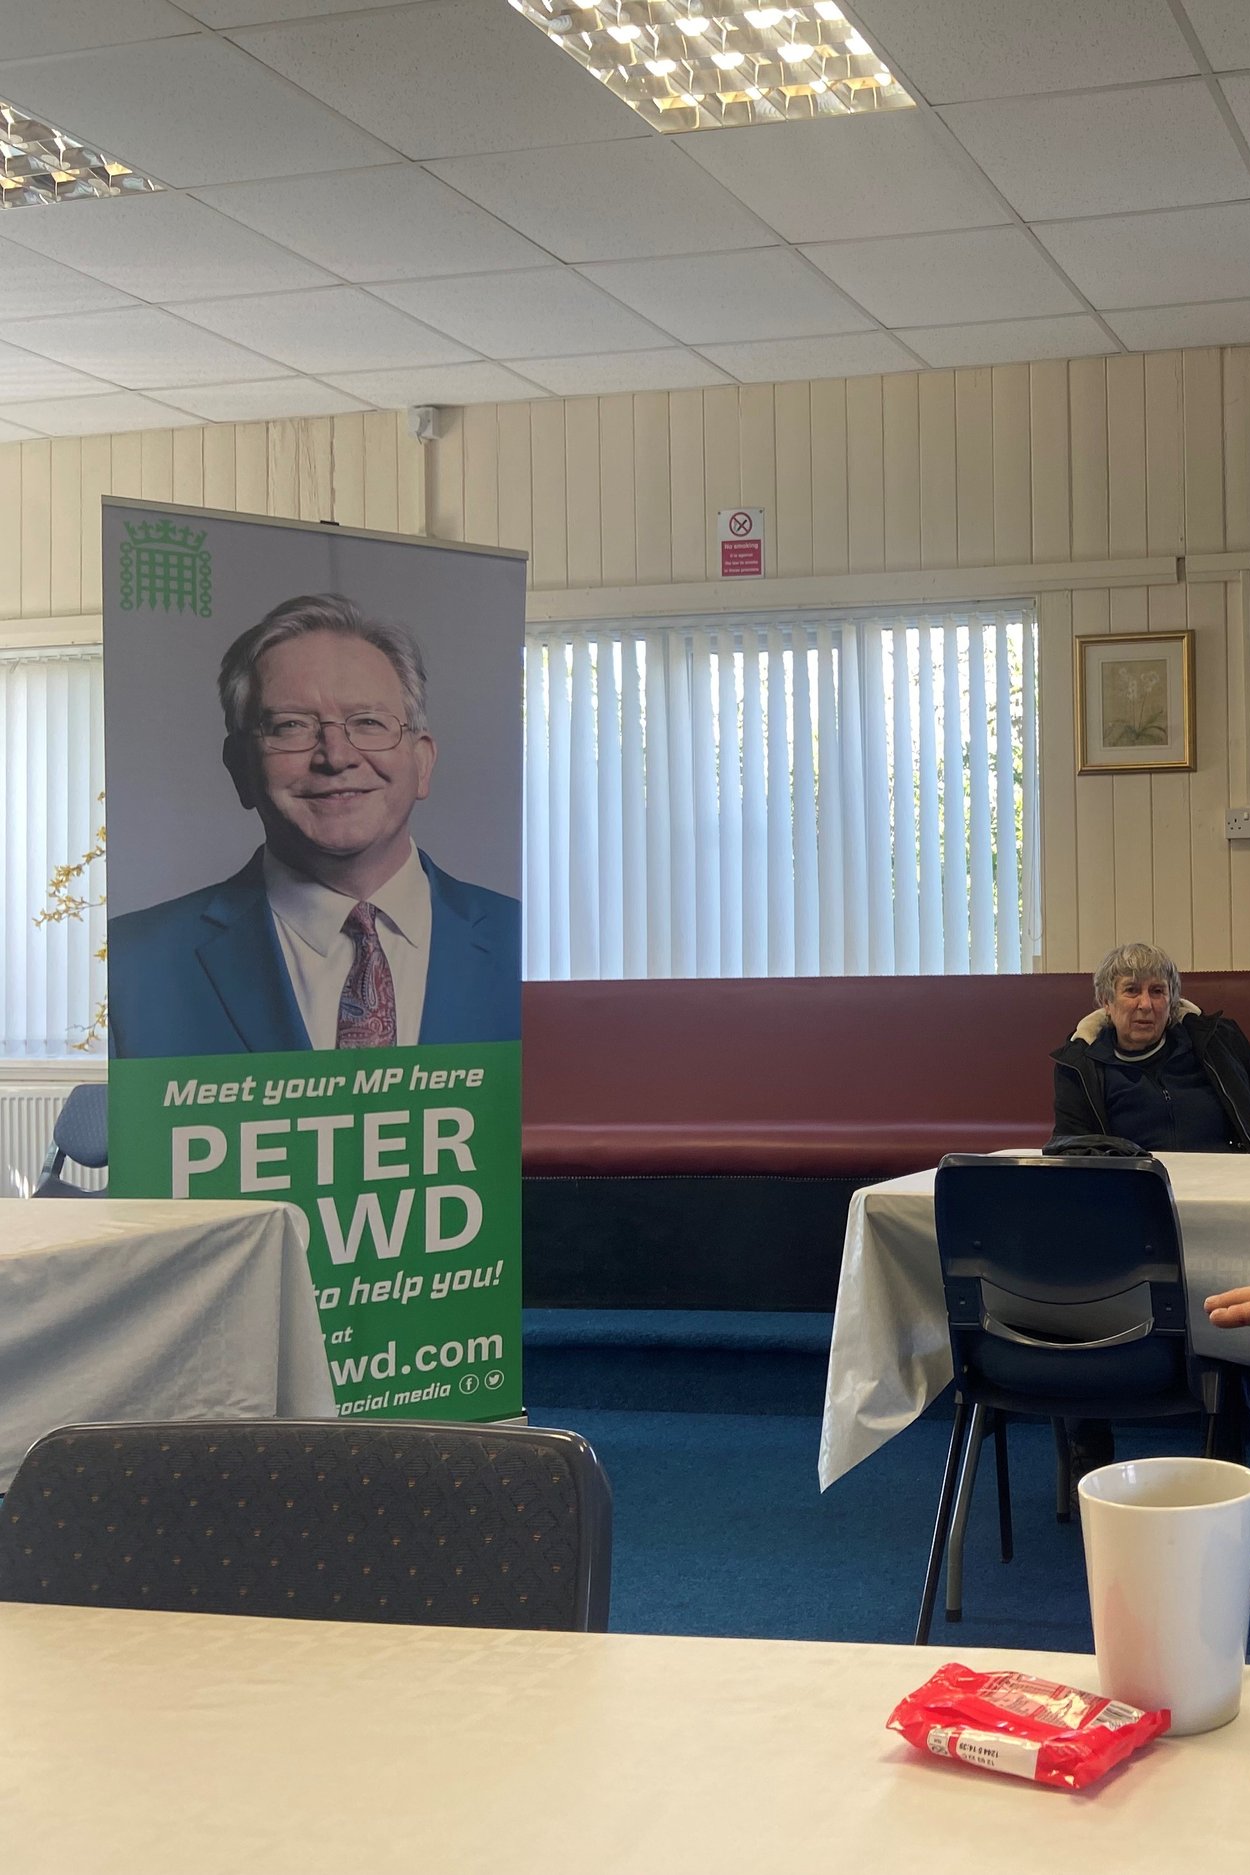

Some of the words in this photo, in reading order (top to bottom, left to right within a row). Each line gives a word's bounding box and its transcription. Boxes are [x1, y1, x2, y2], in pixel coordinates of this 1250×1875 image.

[163, 1076, 257, 1107] Meet
[263, 1076, 346, 1105] your
[352, 1068, 404, 1094] MP
[408, 1064, 485, 1091] here
[171, 1107, 477, 1199] PETER
[287, 1184, 484, 1265] WD
[349, 1270, 424, 1304] help
[430, 1260, 504, 1299] you!
[330, 1326, 353, 1344] at
[392, 1383, 452, 1406] media
